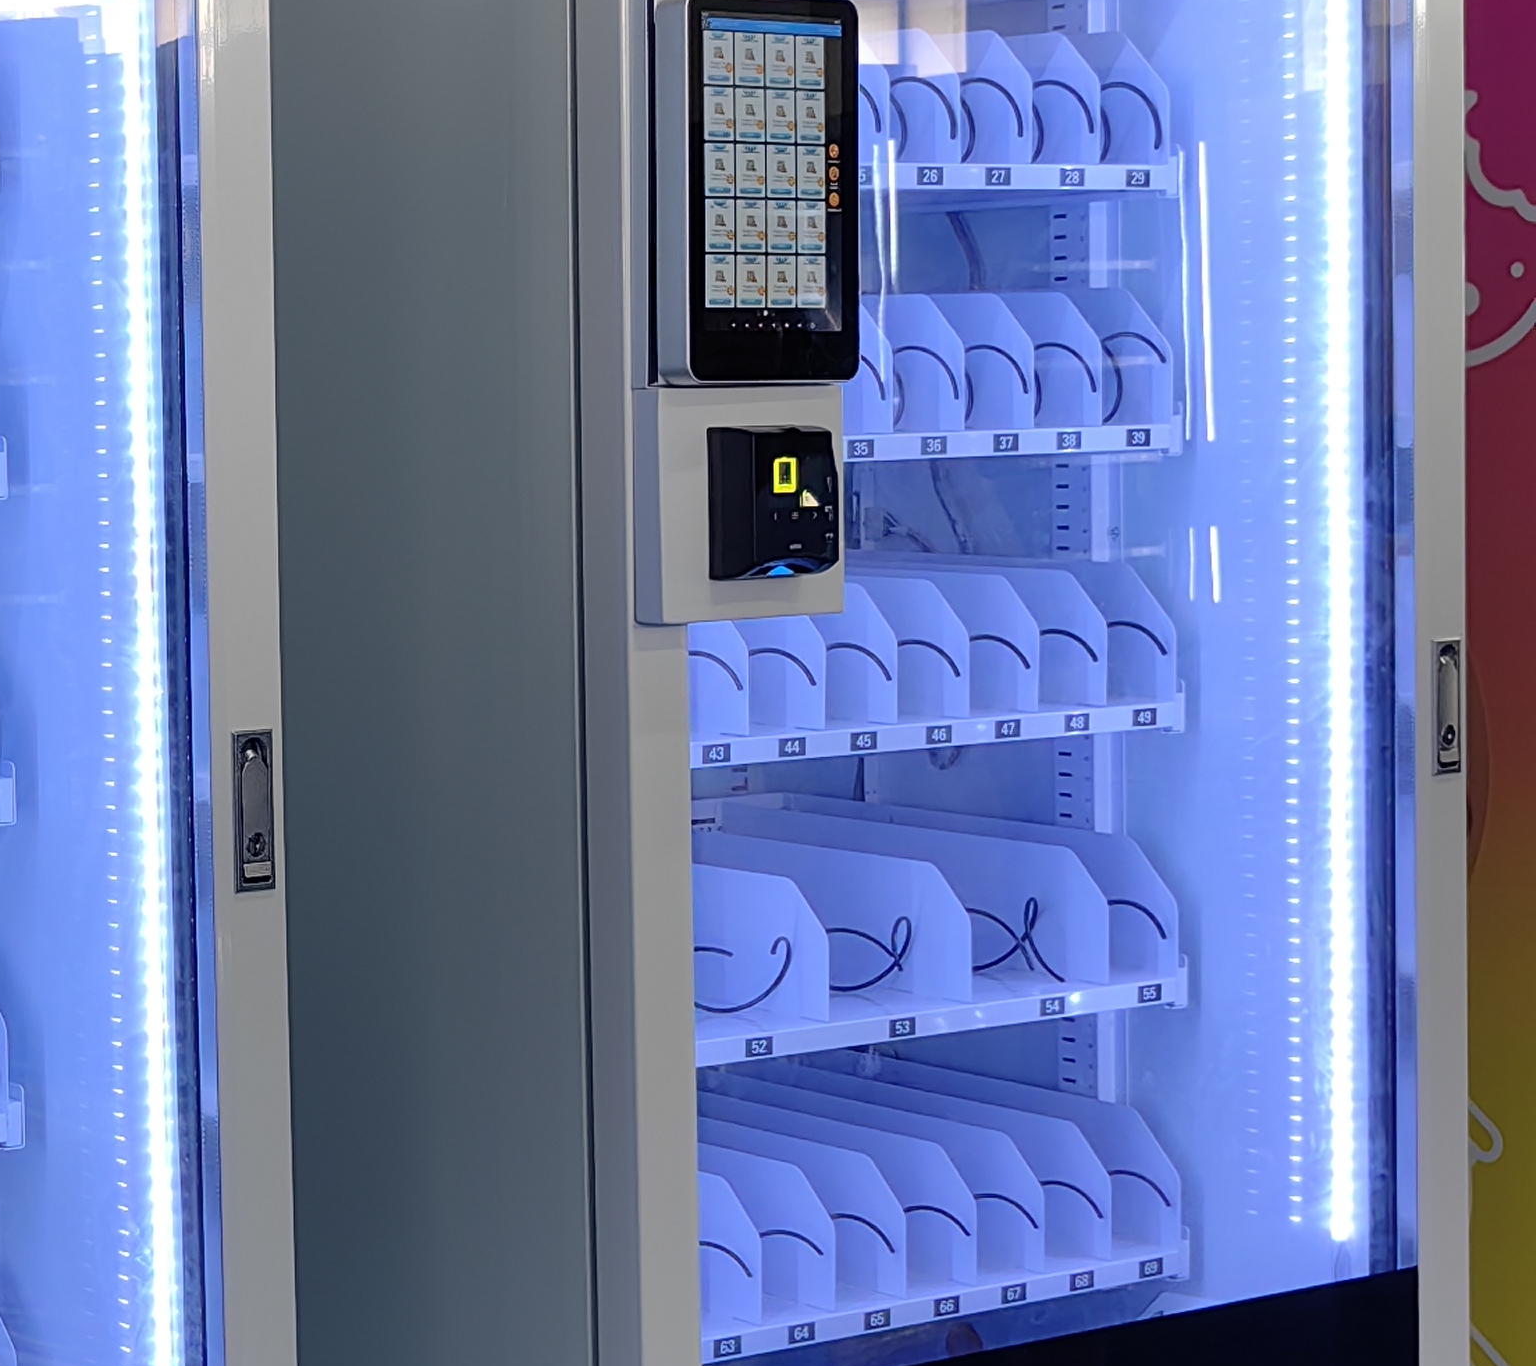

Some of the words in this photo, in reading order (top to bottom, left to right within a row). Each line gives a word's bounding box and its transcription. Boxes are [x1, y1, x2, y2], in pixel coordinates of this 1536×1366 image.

[922, 168, 939, 184] 26
[990, 169, 1006, 184] 27
[1064, 170, 1081, 185] 28
[1130, 170, 1146, 185] 29
[853, 441, 869, 457] 35
[925, 438, 942, 453] 36
[998, 435, 1014, 450] 37
[1061, 432, 1077, 448] 38
[1131, 430, 1146, 445] 39
[708, 745, 725, 761] 43
[783, 739, 801, 754] 44
[855, 733, 872, 749] 45
[931, 727, 948, 742] 46
[1000, 721, 1016, 736] 47
[1069, 715, 1085, 730] 48
[1136, 710, 1153, 725] 49
[751, 1039, 768, 1055] 52
[894, 1019, 911, 1035] 53
[1045, 999, 1061, 1014] 54
[719, 1338, 736, 1355] 63
[793, 1325, 810, 1341] 64
[869, 1311, 886, 1327] 65
[938, 1298, 955, 1314] 66
[1006, 1285, 1022, 1302] 67
[1074, 1273, 1090, 1289] 68
[1143, 1260, 1159, 1276] 69
